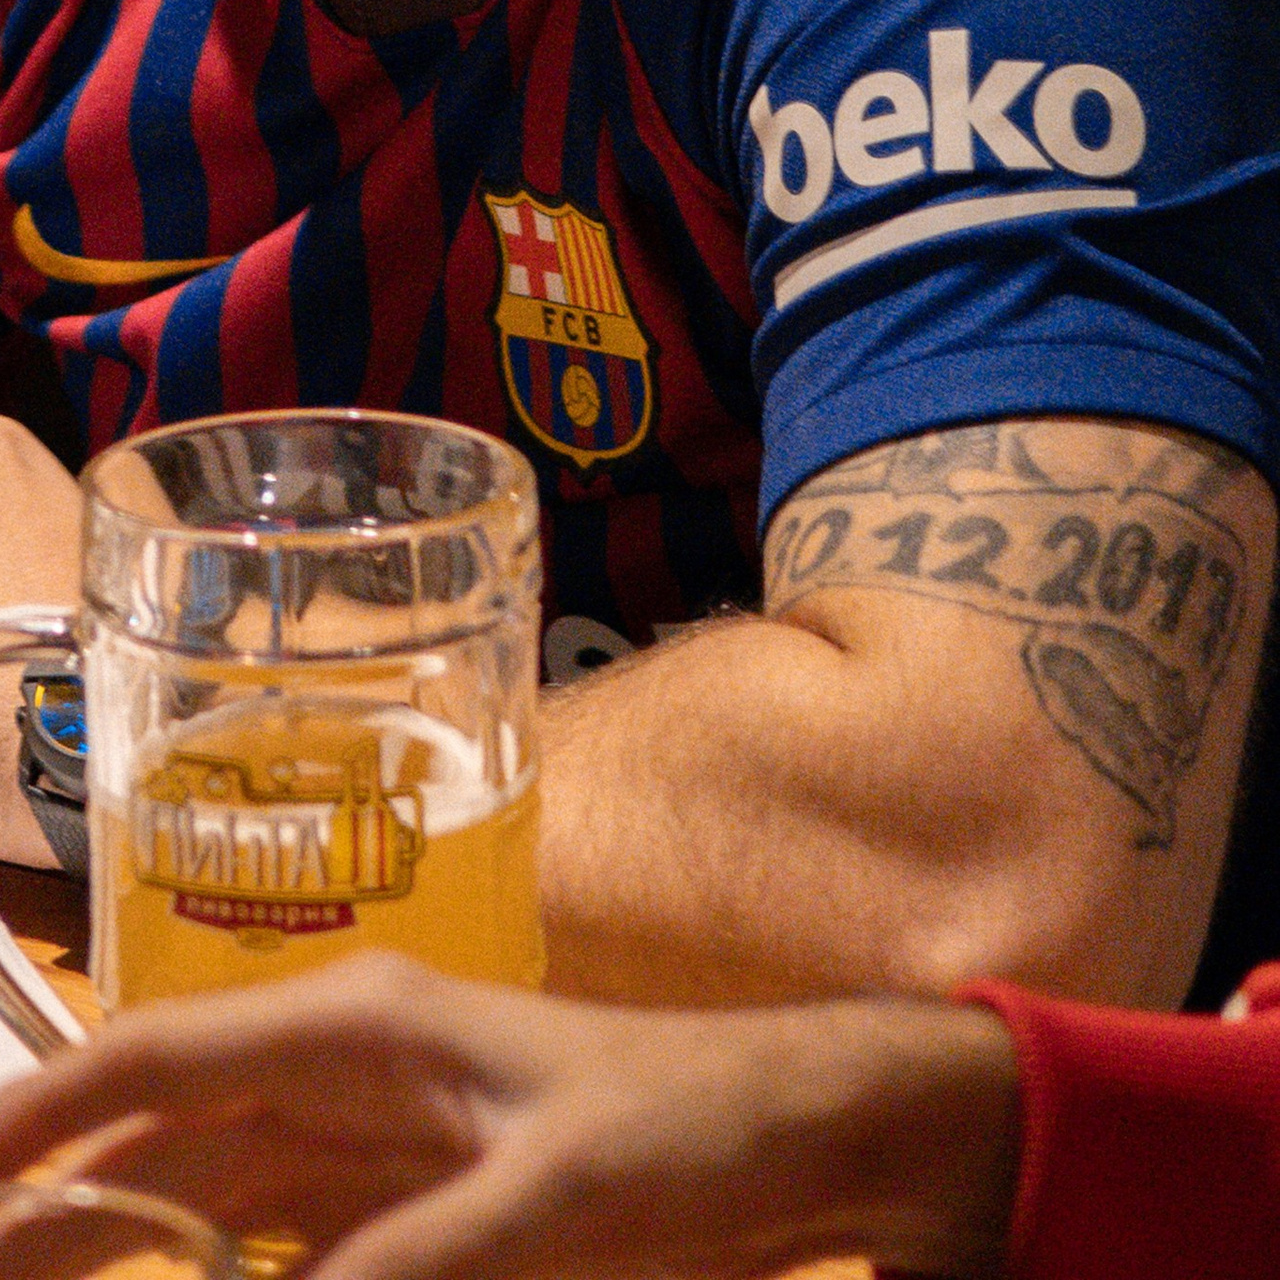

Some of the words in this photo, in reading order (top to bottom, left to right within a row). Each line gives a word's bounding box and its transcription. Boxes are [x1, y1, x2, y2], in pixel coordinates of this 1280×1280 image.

[749, 27, 1147, 224] beko
[542, 306, 602, 346] FCB
[134, 803, 326, 888] ПИНТА
